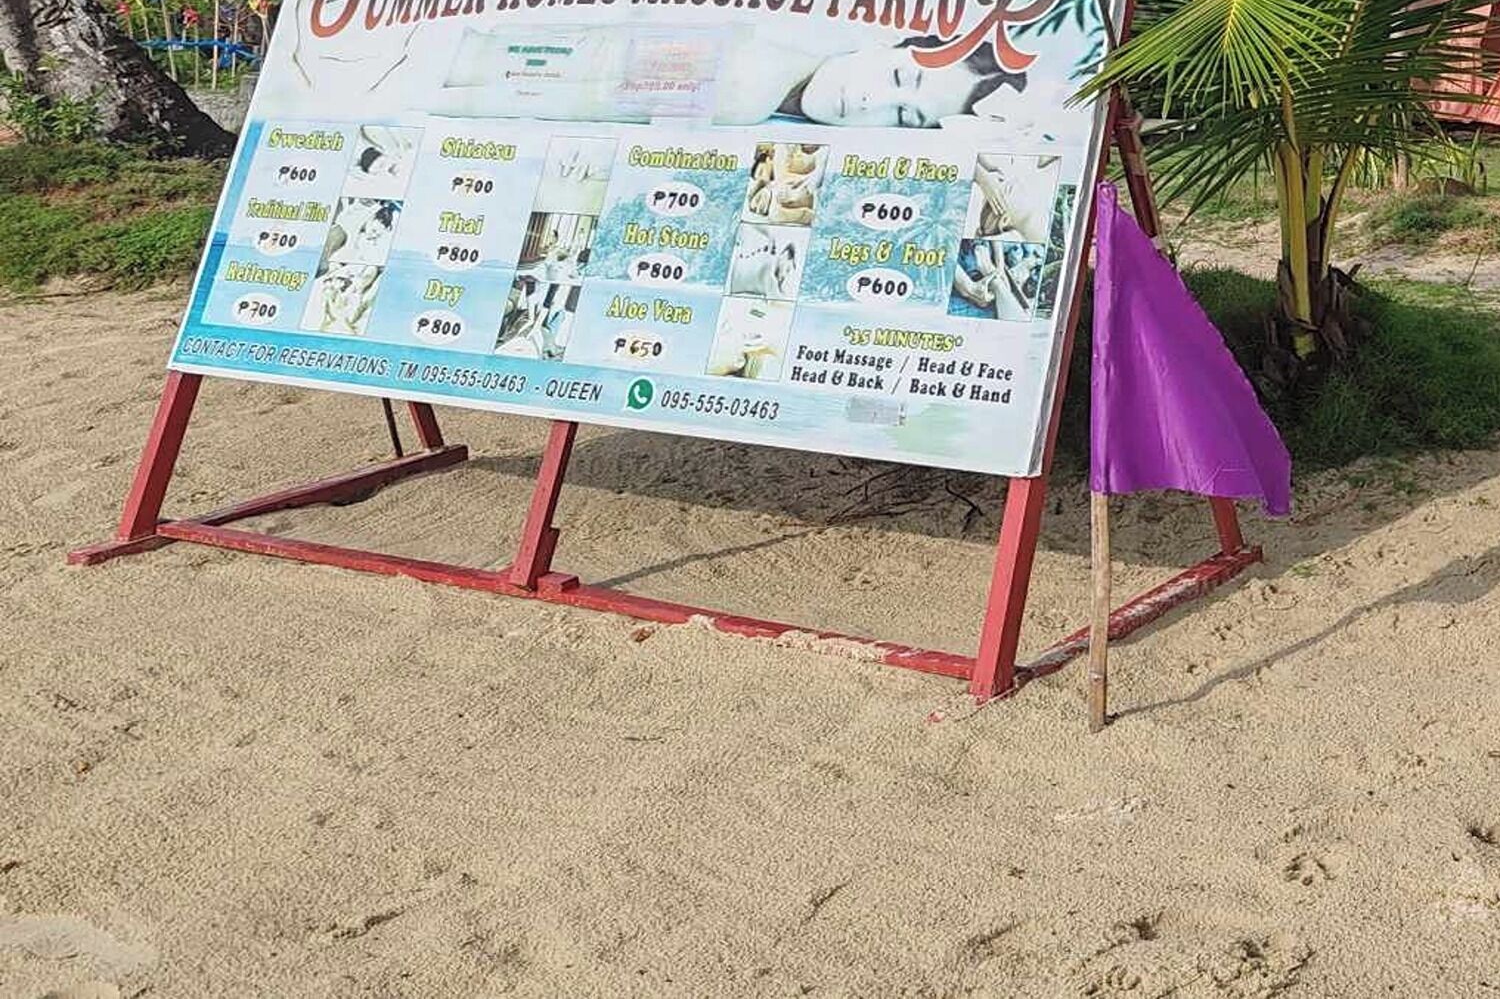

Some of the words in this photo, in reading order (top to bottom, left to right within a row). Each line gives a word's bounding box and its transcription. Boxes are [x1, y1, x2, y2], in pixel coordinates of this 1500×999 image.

[269, 128, 344, 151] Swedish
[440, 136, 517, 161] Shiatsu
[629, 145, 739, 171] Combination
[842, 154, 889, 179] Head
[894, 156, 910, 180] &
[914, 158, 958, 182] Face
[439, 211, 484, 236] Thai
[624, 223, 654, 247] Hot
[659, 226, 710, 250] Stone
[829, 237, 871, 266] Legs
[876, 239, 892, 263] &
[902, 242, 946, 267] Foot
[225, 261, 309, 292] Reflexology
[424, 278, 465, 307] Dry
[606, 295, 649, 320] Aloe
[654, 299, 693, 324] Vera
[183, 337, 246, 359] CONTACT
[247, 344, 278, 362] FOR
[279, 347, 390, 376] RESERVATIONS:
[397, 361, 420, 378] TM
[421, 365, 527, 394] 095-555-03463
[545, 379, 604, 402] QUEEN
[796, 344, 829, 362] Foot
[833, 348, 893, 371] Massage
[899, 356, 910, 374] /
[917, 357, 956, 376] Head
[960, 360, 974, 376] &
[977, 362, 1014, 381] Face
[791, 365, 828, 384] Head
[831, 370, 845, 386] &
[847, 372, 884, 390] Back
[891, 377, 901, 395] /
[909, 378, 947, 398] Back
[952, 382, 965, 398] &
[969, 385, 1012, 404] Hand
[660, 389, 780, 421] 095-555-03463
